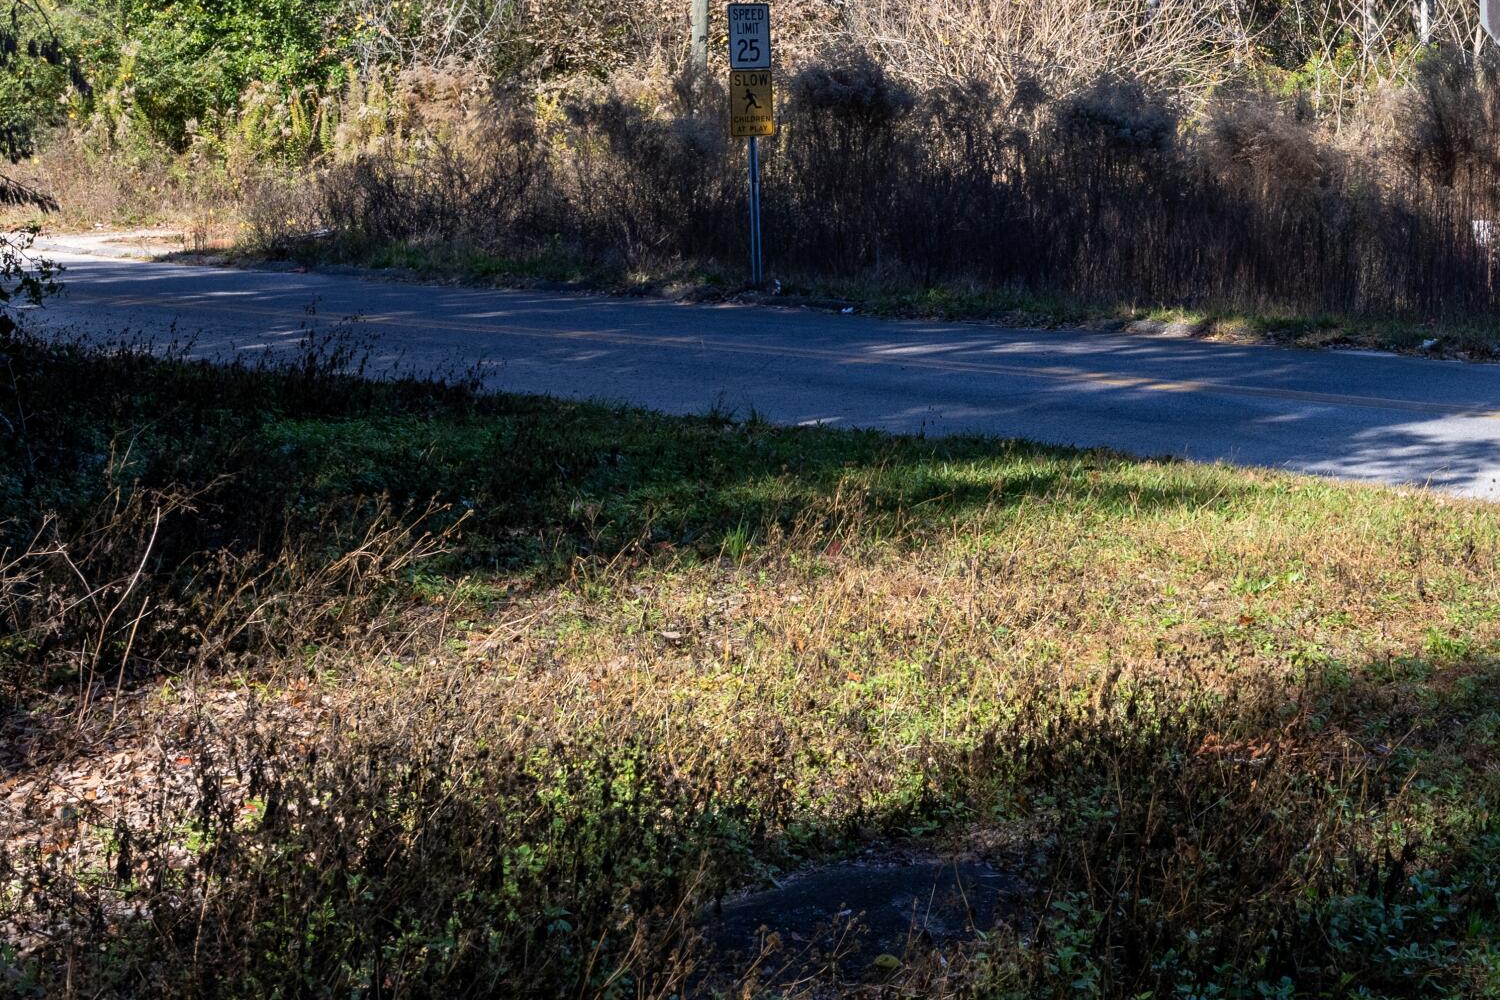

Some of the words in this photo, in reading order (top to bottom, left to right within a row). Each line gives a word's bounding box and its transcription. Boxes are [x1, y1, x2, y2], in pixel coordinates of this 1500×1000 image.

[732, 8, 764, 21] SPEED
[736, 22, 760, 35] LIMIT
[737, 39, 760, 63] 25
[734, 74, 768, 87] SLOW
[733, 115, 771, 124] CHILDREN
[737, 126, 745, 134] AT
[750, 125, 768, 133] PLAY
